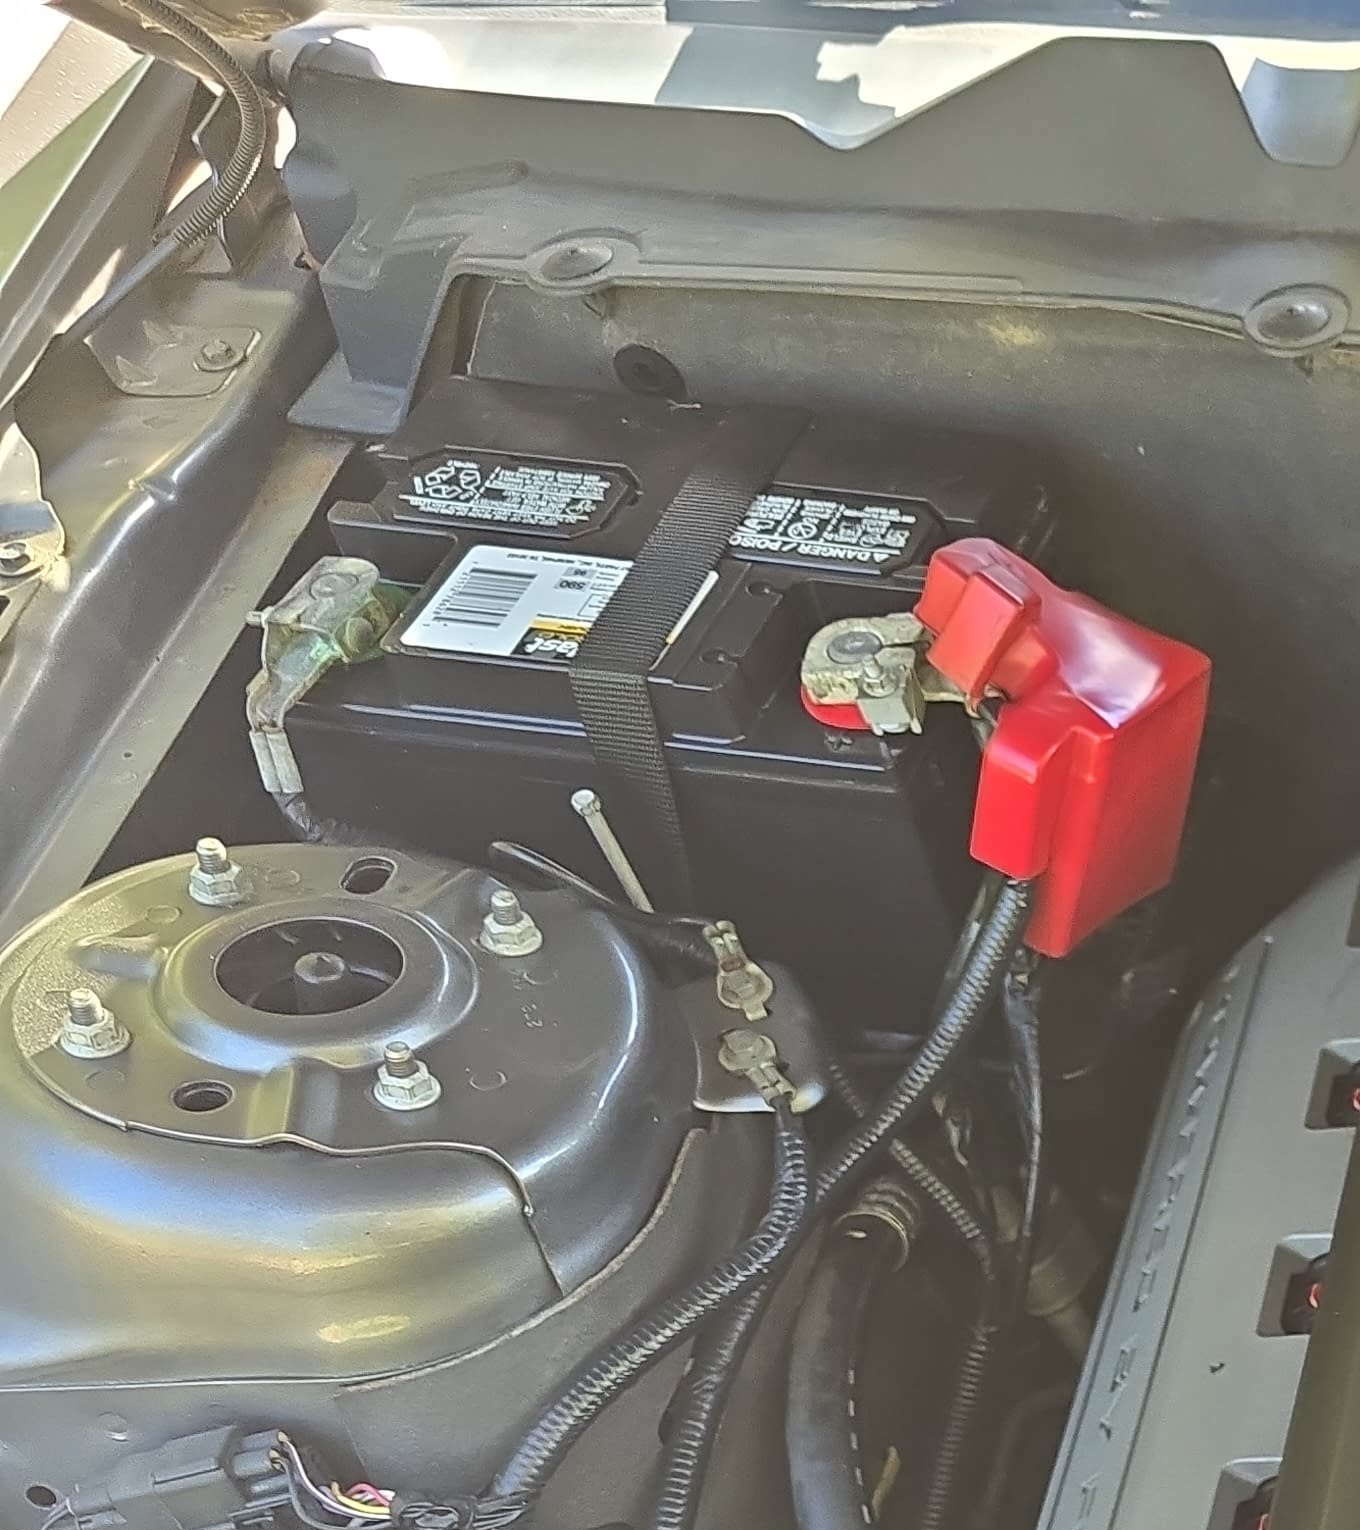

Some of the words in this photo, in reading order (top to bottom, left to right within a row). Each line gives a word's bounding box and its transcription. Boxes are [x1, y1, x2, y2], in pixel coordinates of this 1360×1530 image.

[729, 534, 782, 552] POISO
[798, 545, 871, 563] DANGER
[524, 636, 578, 658] last
